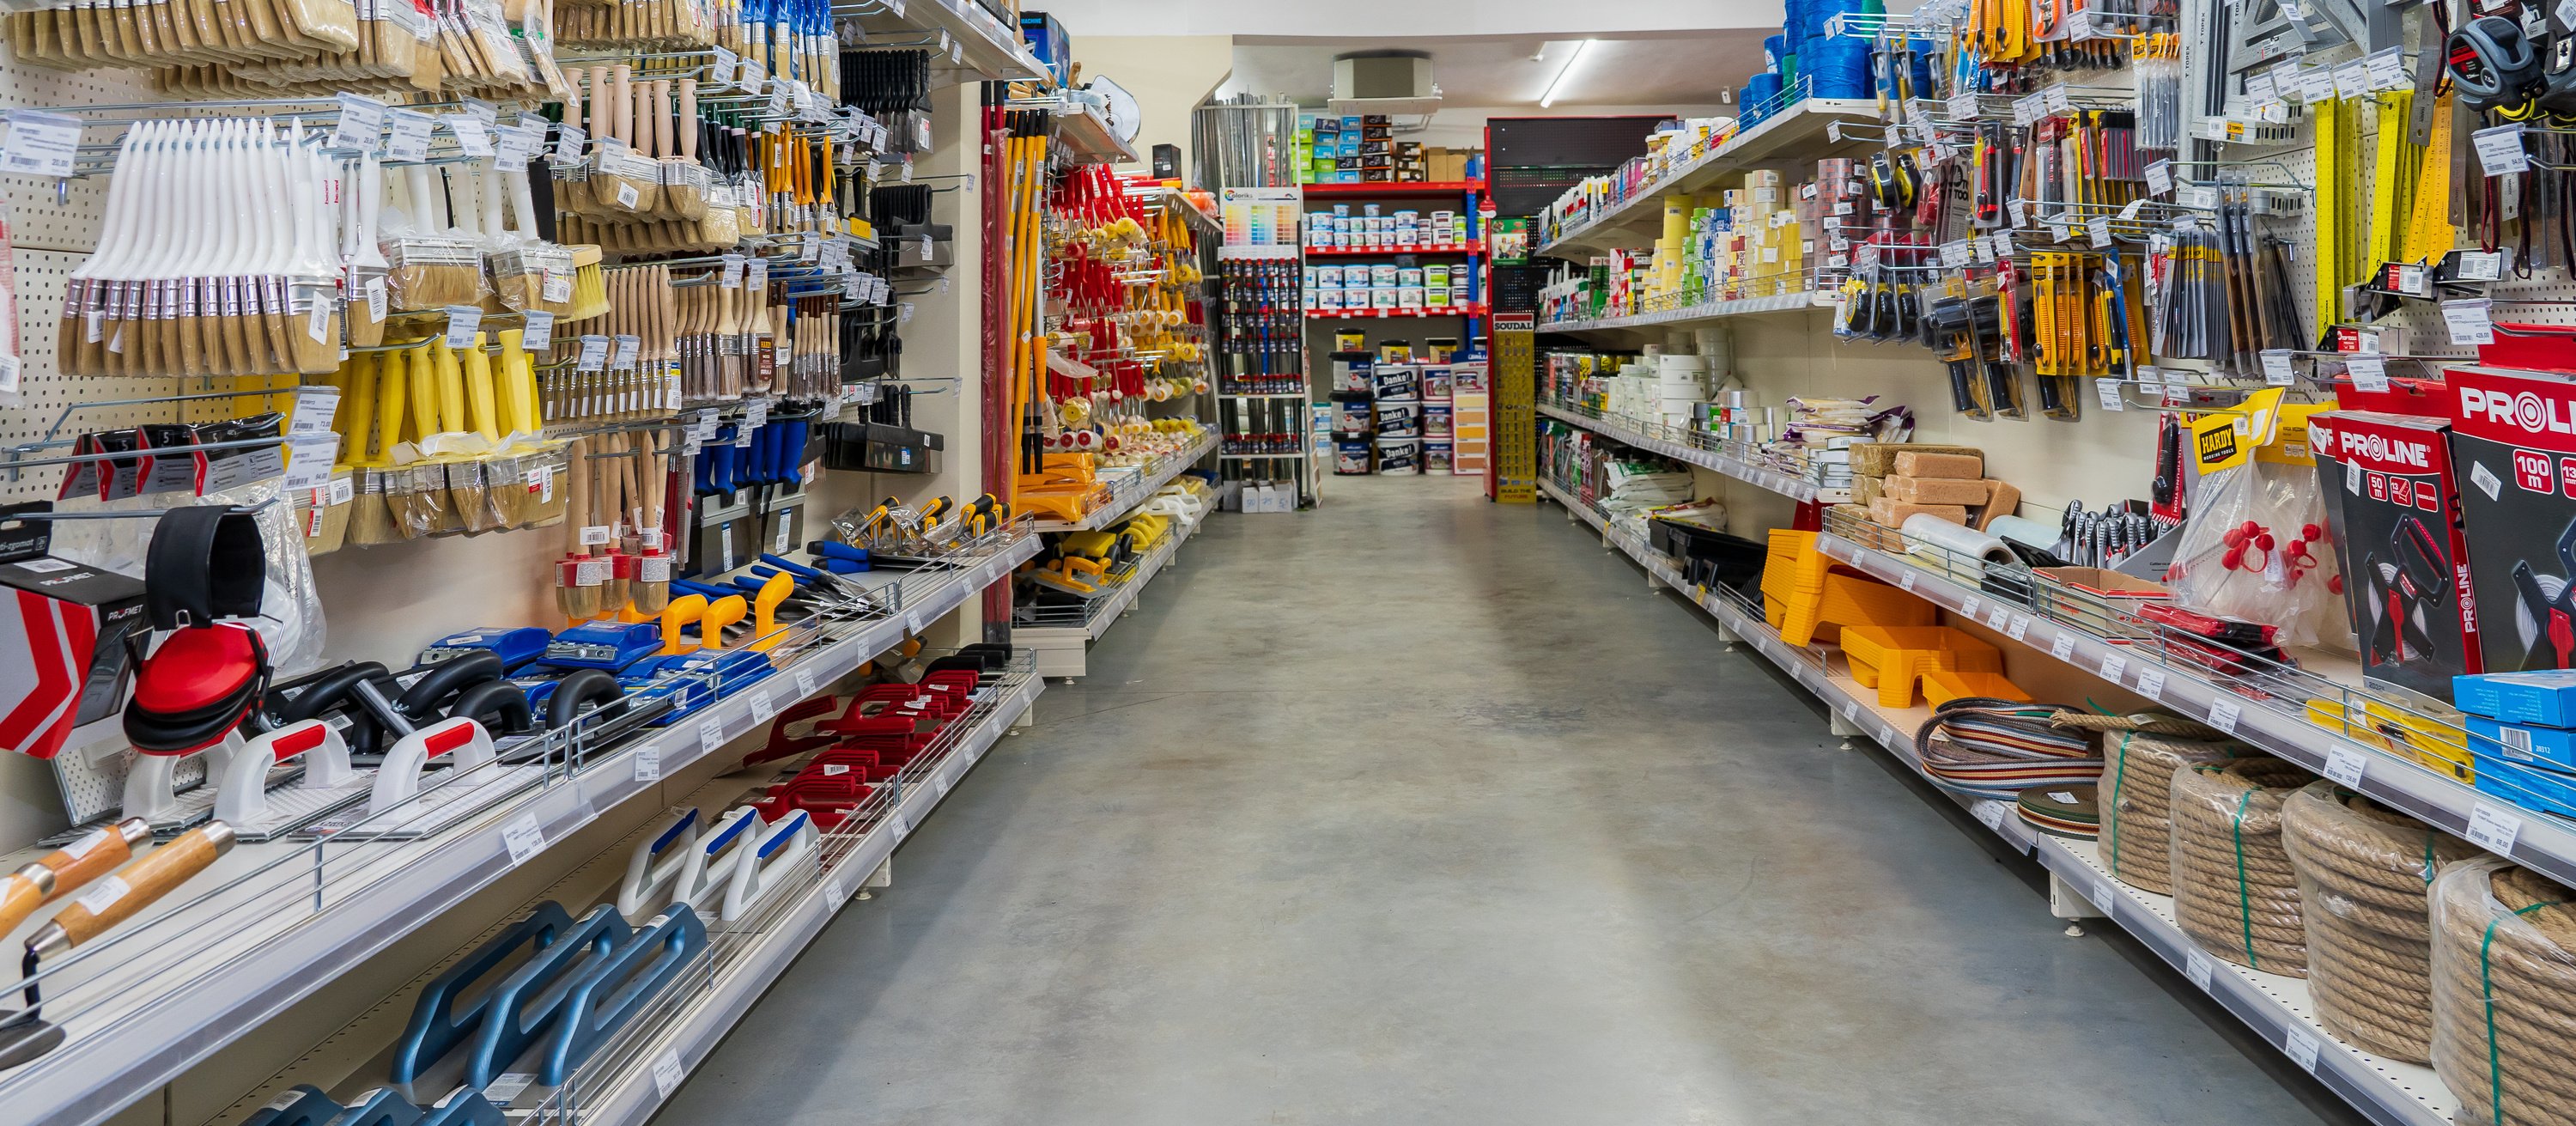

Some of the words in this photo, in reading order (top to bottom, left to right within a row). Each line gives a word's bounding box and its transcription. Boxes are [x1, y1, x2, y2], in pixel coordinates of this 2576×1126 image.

[1953, 190, 1968, 201] TOO
[1383, 372, 1410, 386] Danke!
[1380, 409, 1406, 422] Danke!
[2459, 386, 2576, 435] PROLI
[2201, 428, 2233, 453] HARDY
[1385, 445, 1413, 459] Danke!
[2203, 451, 2221, 461] WORKING
[2221, 447, 2234, 456] TOOLS
[2340, 431, 2429, 468] PROLINE
[2517, 456, 2549, 477] 100
[2371, 476, 2383, 490] 50
[2391, 482, 2398, 491] 13
[2528, 475, 2543, 489] m
[2374, 490, 2383, 498] m
[2457, 563, 2476, 633] PROLINE
[2535, 745, 2551, 754] 20312
